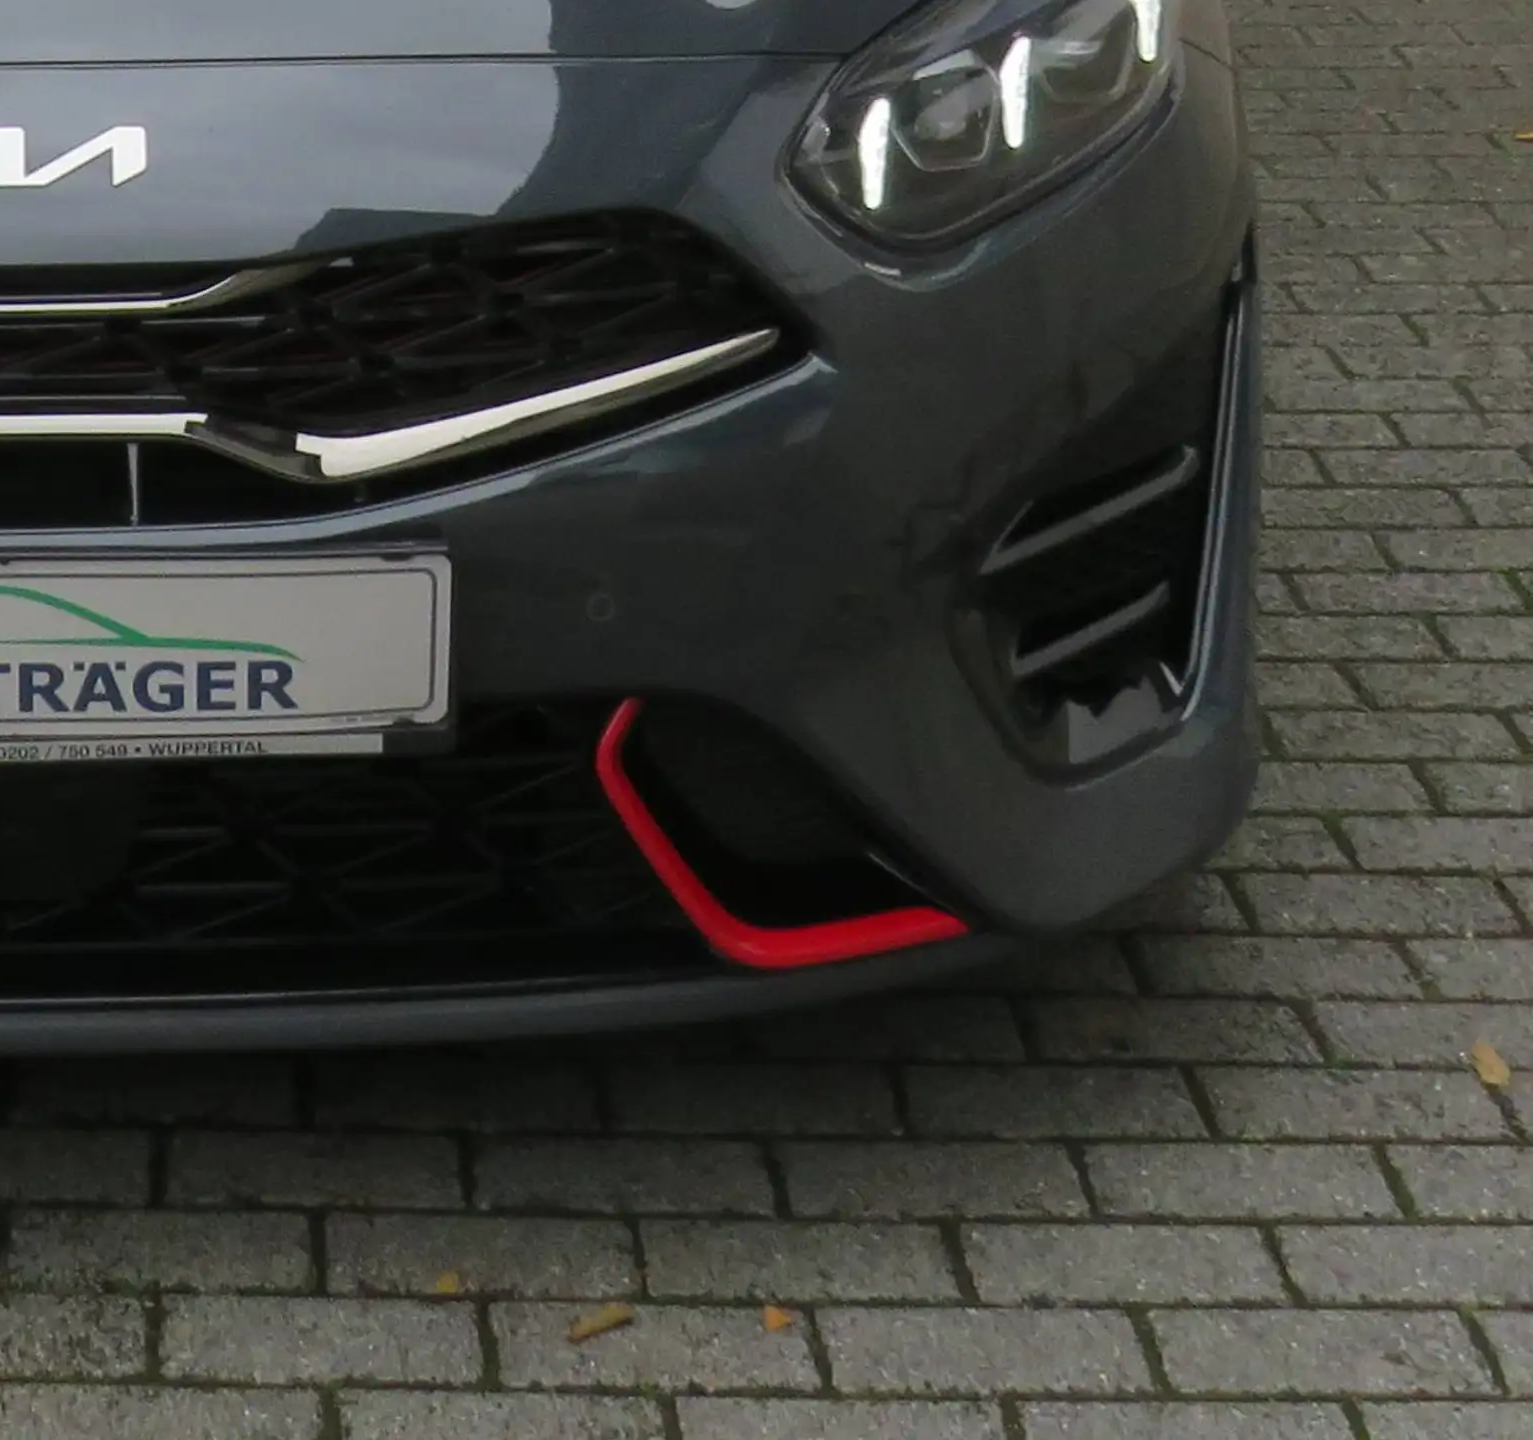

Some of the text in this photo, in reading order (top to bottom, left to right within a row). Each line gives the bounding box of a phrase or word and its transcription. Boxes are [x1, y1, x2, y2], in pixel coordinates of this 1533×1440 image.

[58, 744, 91, 758] 750
[95, 743, 128, 757] 549
[148, 740, 268, 755] WUPPERTAL
